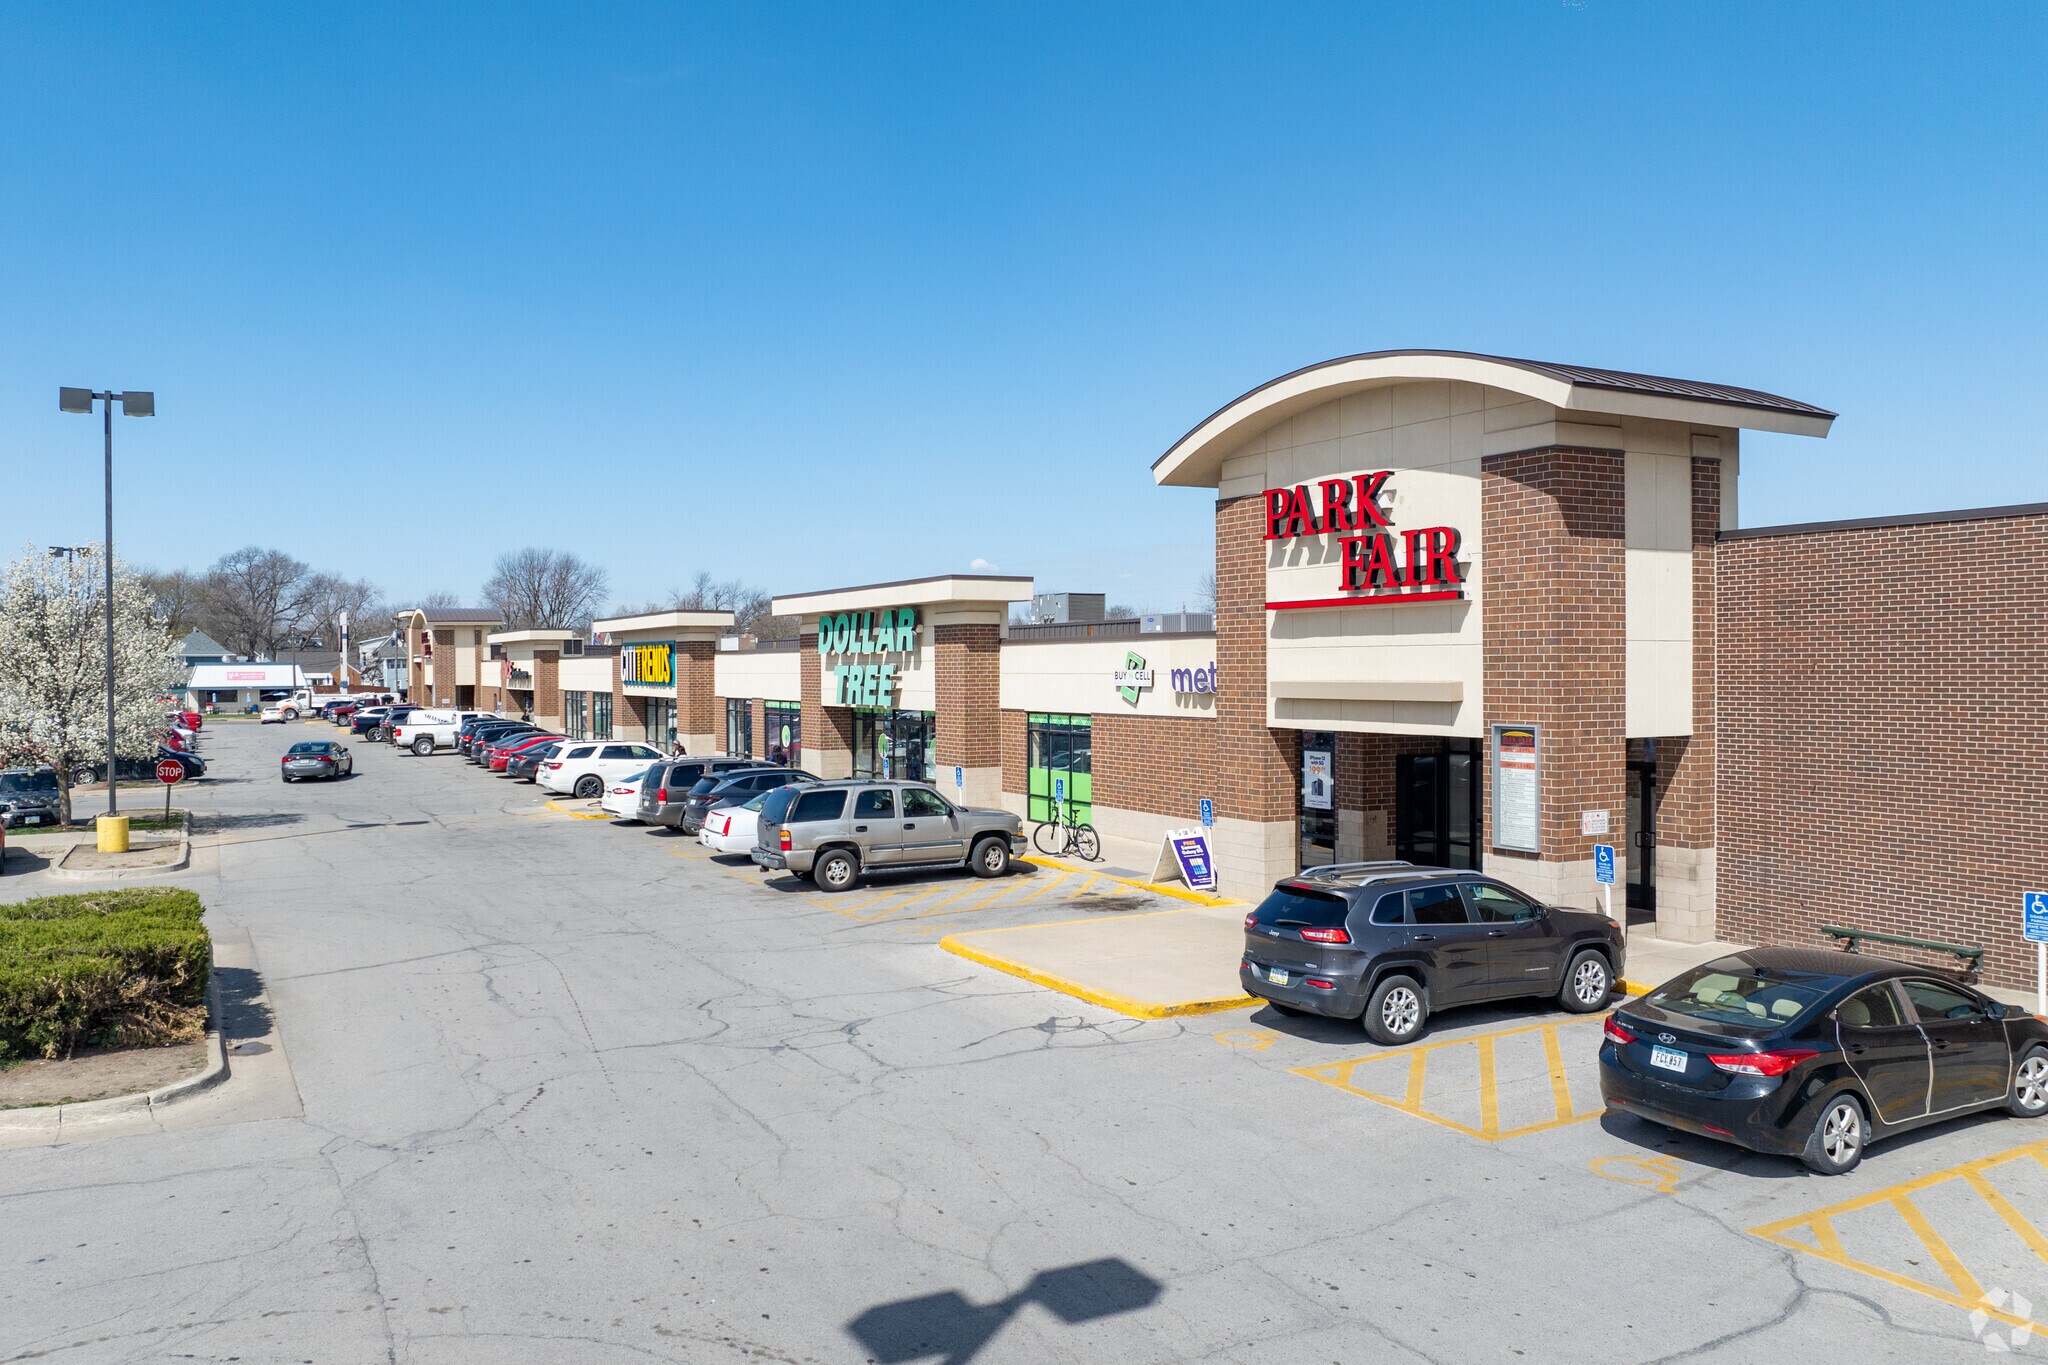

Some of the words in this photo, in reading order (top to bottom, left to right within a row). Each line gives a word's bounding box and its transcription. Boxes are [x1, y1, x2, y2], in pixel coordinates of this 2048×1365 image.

[1263, 471, 1393, 540] PARK
[1338, 527, 1463, 591] FAIR
[818, 608, 915, 655] DOLLAR
[636, 644, 670, 683] TRENDS
[1115, 671, 1127, 680] BUY
[1135, 671, 1151, 680] CELL
[834, 664, 894, 706] TREE
[158, 766, 181, 777] STOP
